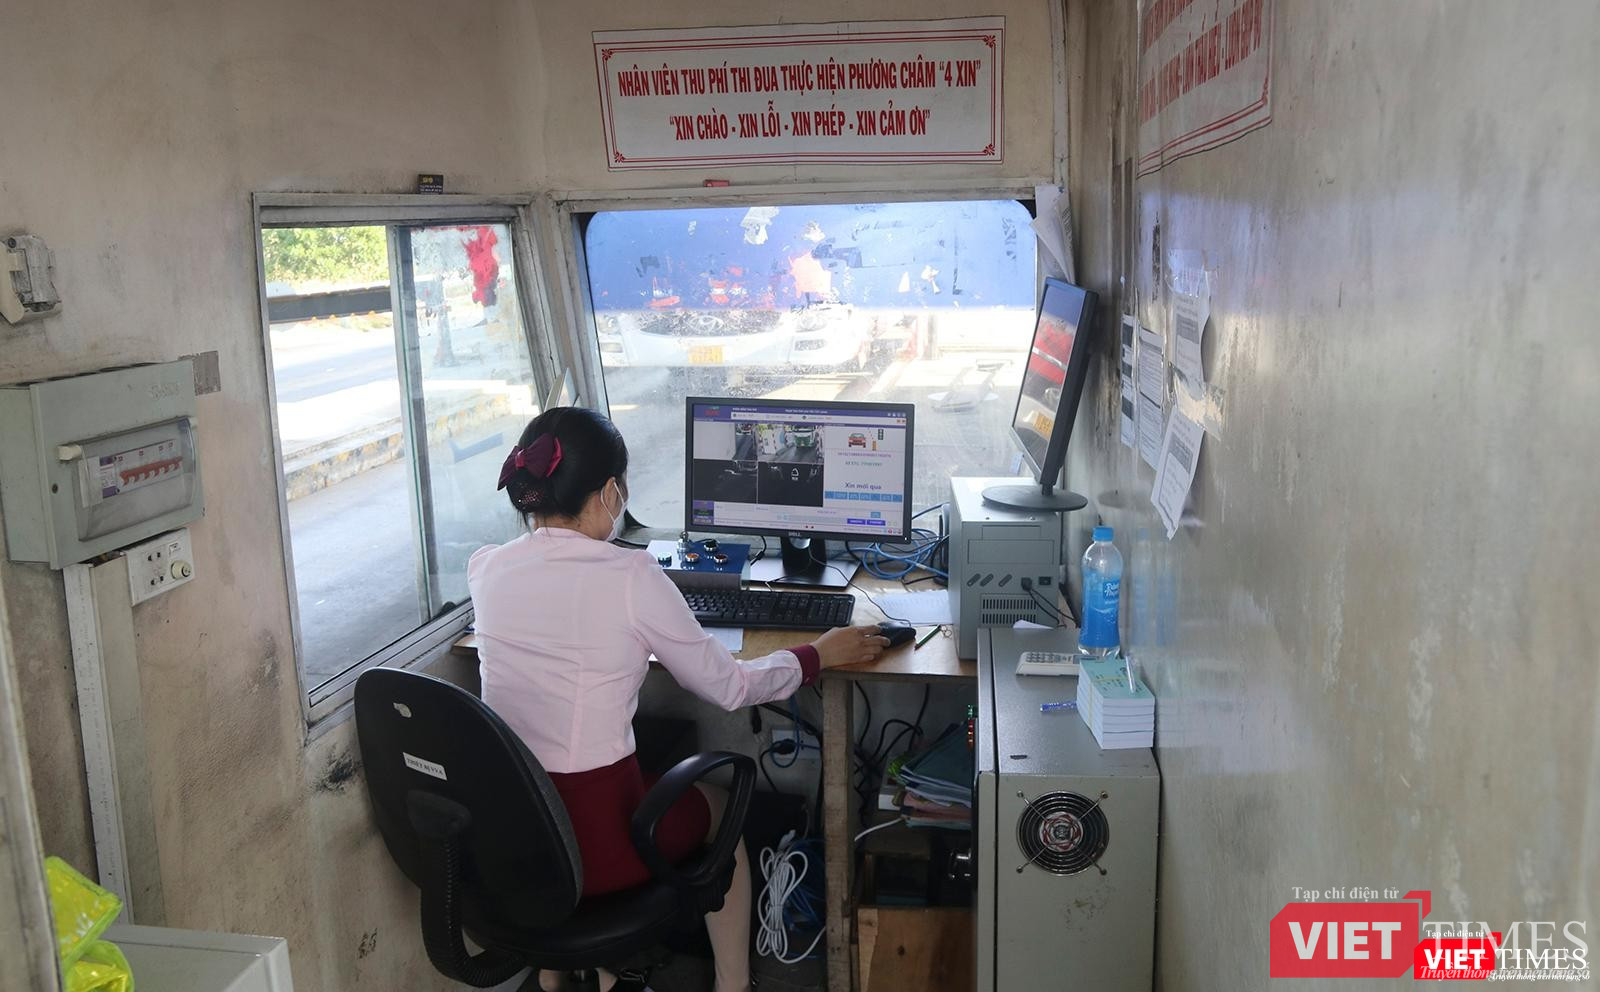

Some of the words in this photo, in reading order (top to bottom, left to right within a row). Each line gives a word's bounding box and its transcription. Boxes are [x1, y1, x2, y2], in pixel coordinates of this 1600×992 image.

[618, 64, 650, 96] NHÂN
[652, 63, 680, 95] VIÊN
[681, 68, 705, 95] THU
[708, 61, 728, 94] PHÍ
[730, 66, 750, 93] THI
[754, 66, 779, 93] ĐUA
[781, 60, 813, 96] THỰC
[816, 57, 845, 95] HIỆN
[849, 58, 897, 90] PHƯƠNG
[901, 54, 935, 89] CHÂM
[697, 108, 728, 140] CHÀO
[738, 113, 759, 138] XIN
[761, 101, 781, 137] LỖI
[791, 111, 811, 137] XIN
[815, 104, 845, 136] PHÉP
[856, 110, 876, 136] XIN
[879, 100, 906, 136] CẢM
